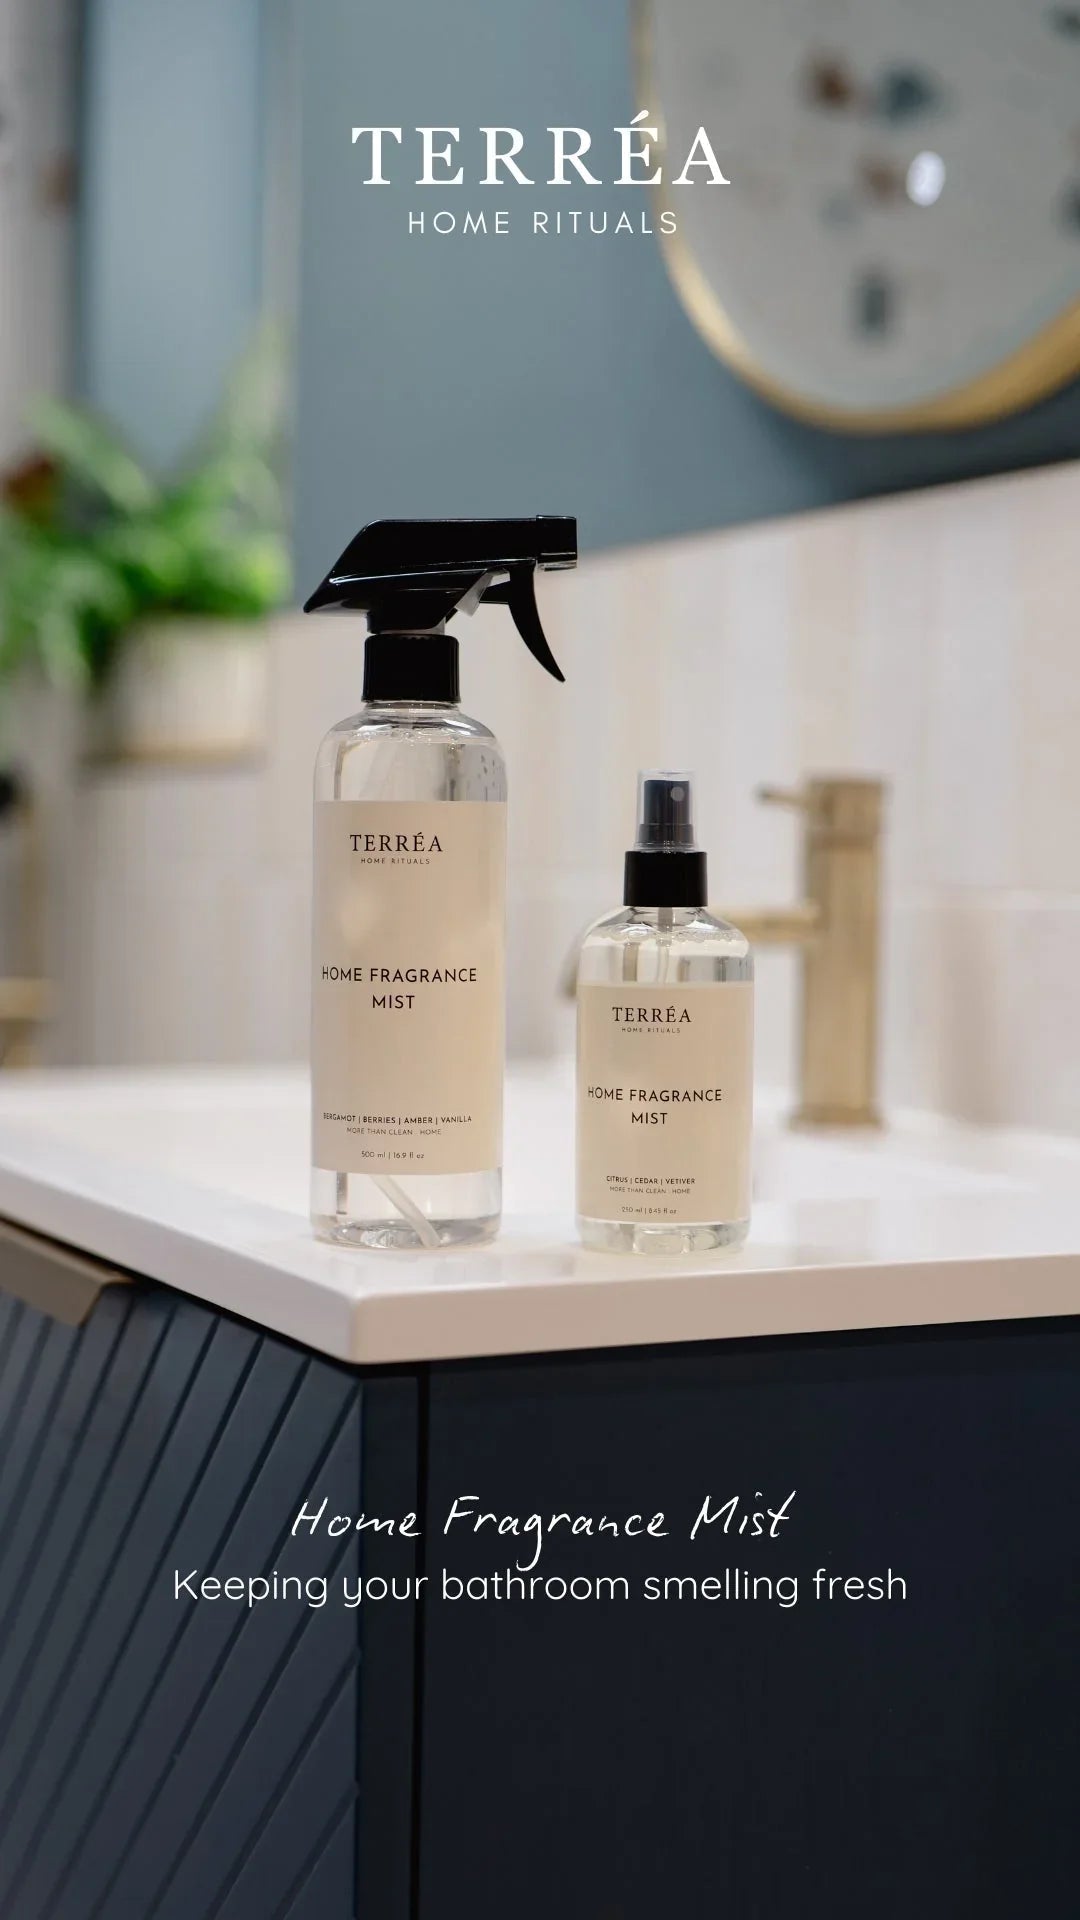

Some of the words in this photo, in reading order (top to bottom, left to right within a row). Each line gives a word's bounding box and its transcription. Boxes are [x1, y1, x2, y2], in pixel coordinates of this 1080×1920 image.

[349, 832, 443, 852] TERRÉA
[322, 966, 363, 982] HOME
[370, 968, 477, 983] FRAGRANCE
[372, 995, 415, 1009] MIST
[612, 1005, 692, 1023] TERRÉA
[588, 1086, 623, 1101] HOME
[629, 1089, 722, 1102] FRAGRANCE
[323, 1112, 356, 1122] BERGAMOT
[363, 1116, 396, 1124] BERRIES
[440, 1115, 472, 1123] VANILLA
[631, 1112, 668, 1124] MIST
[346, 1127, 365, 1135] MORE
[388, 1128, 413, 1136] CLEAN
[420, 1128, 442, 1136] HOME
[361, 1150, 375, 1158] 500
[606, 1175, 629, 1183] CITRUS
[634, 1177, 659, 1185] CEDAR
